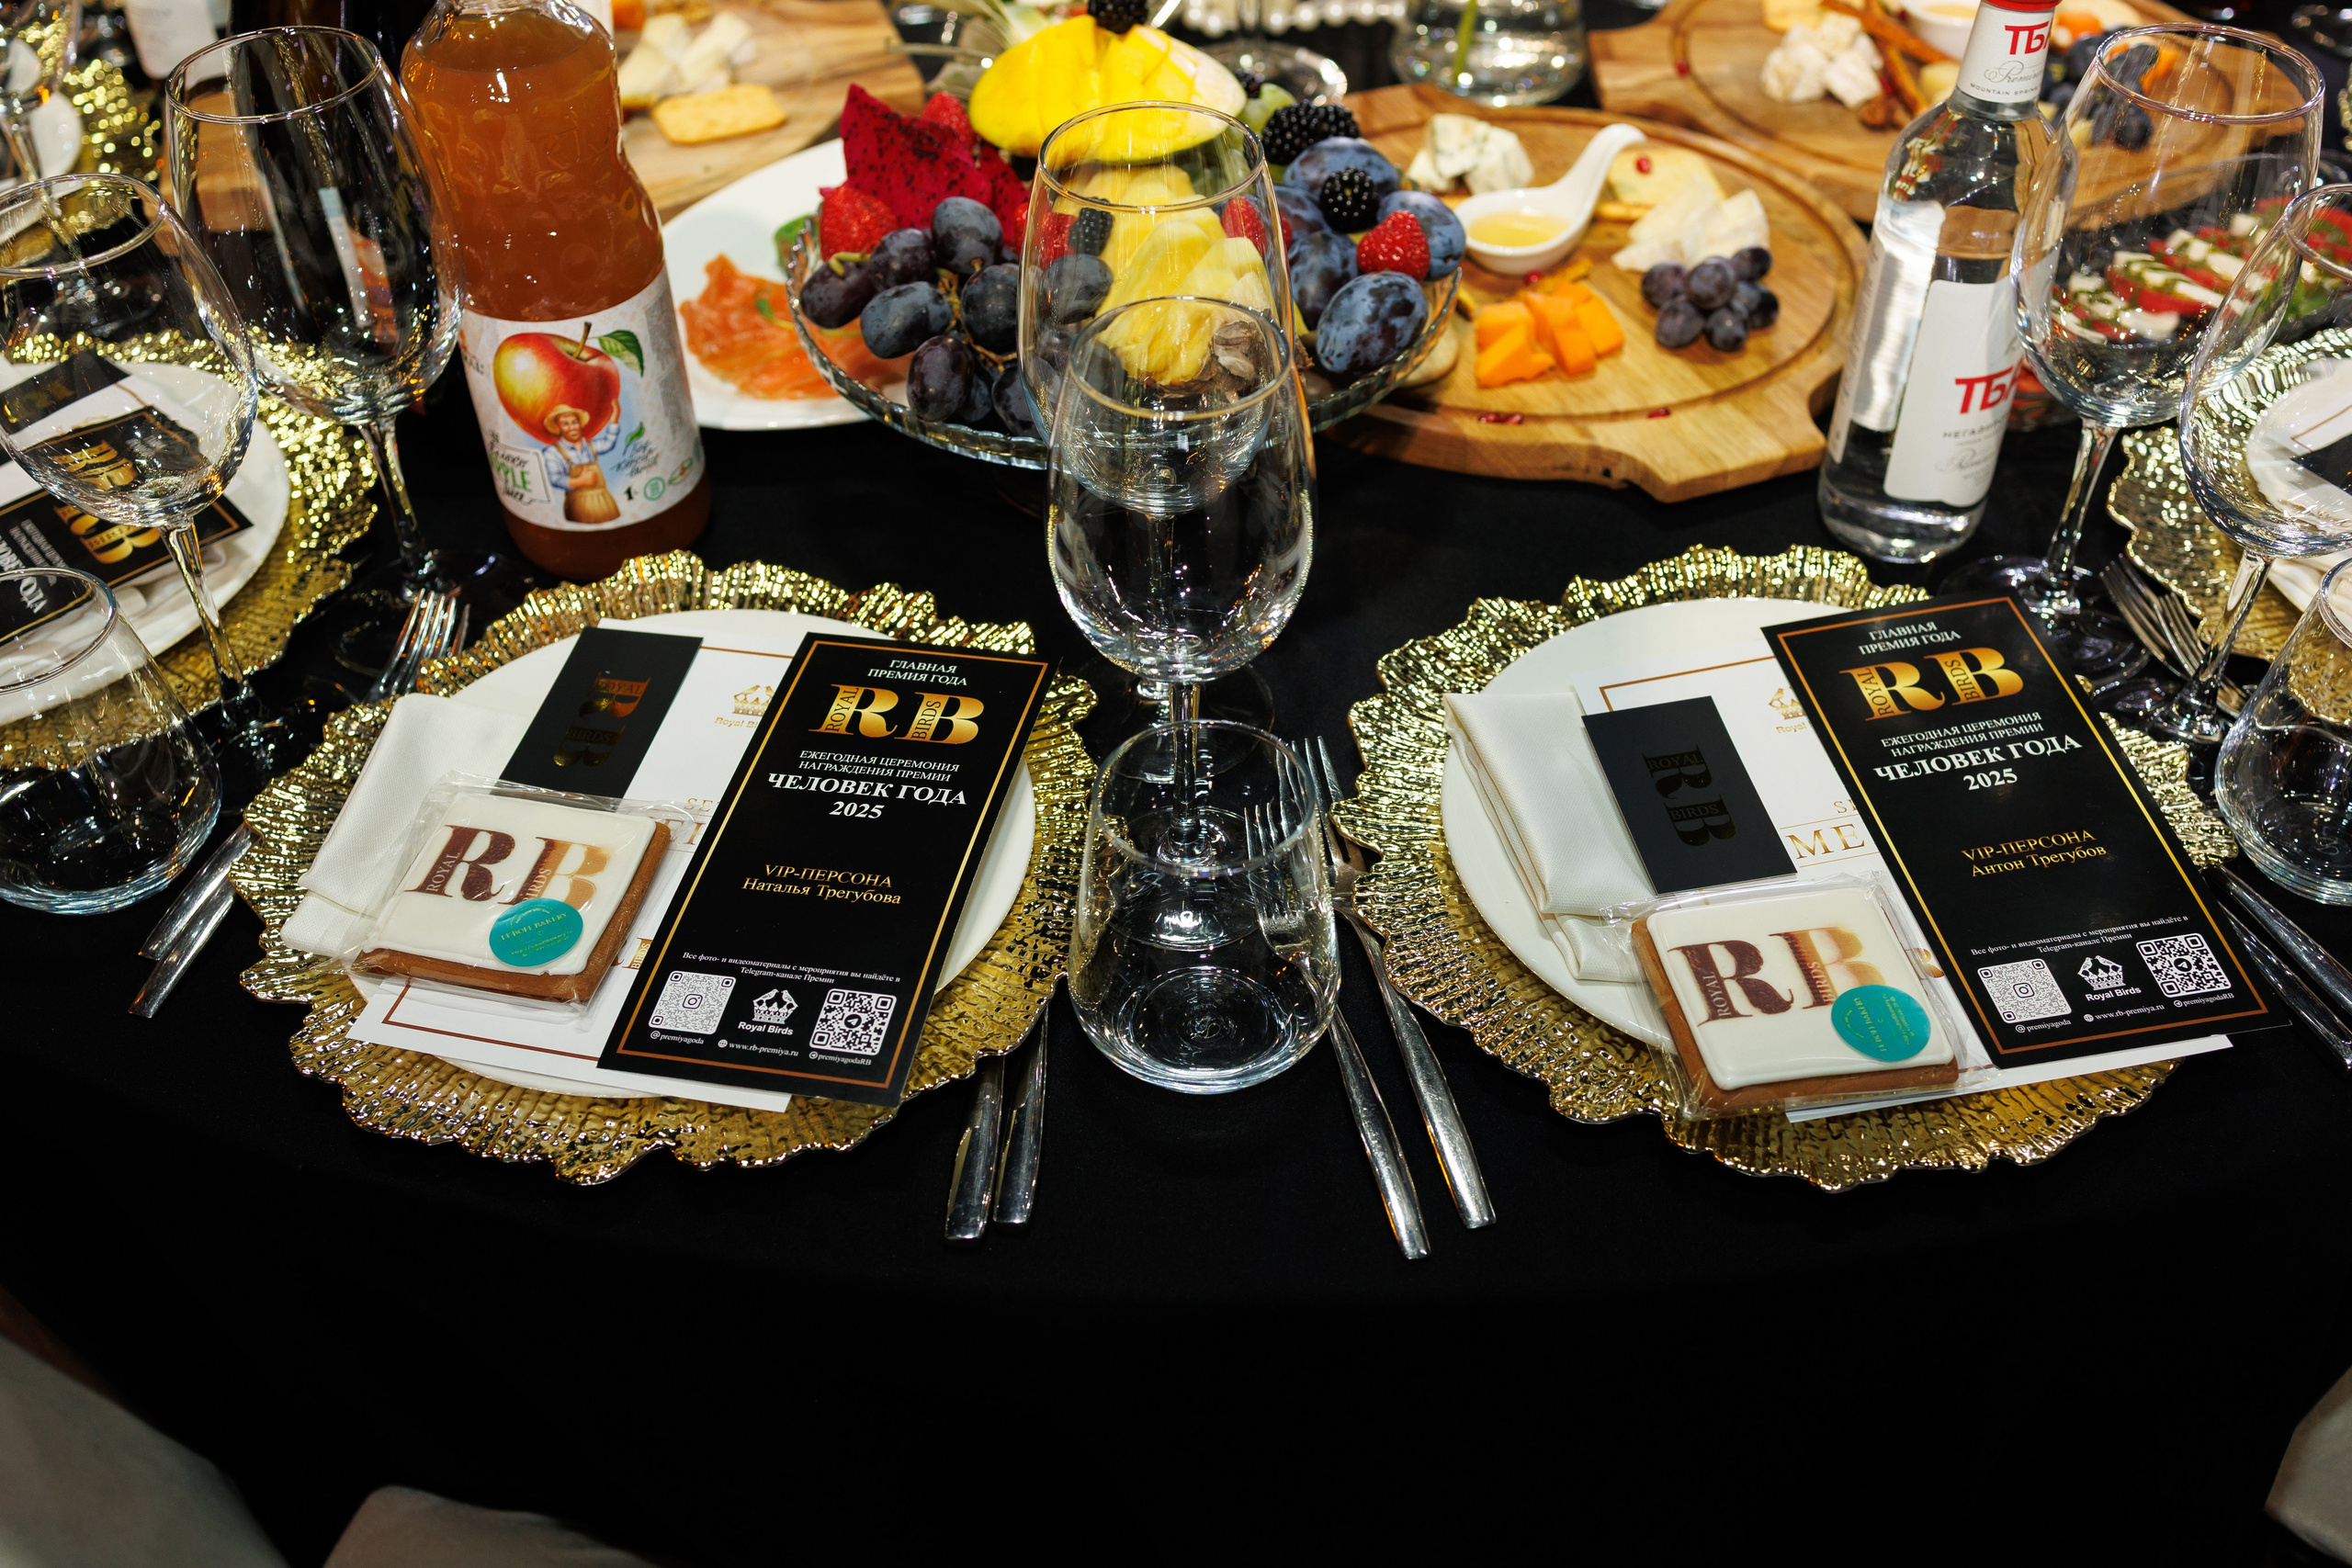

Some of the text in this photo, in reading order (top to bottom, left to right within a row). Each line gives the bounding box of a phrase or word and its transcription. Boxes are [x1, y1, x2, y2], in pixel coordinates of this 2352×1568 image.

[1970, 83, 2010, 96] MOUNTAIN
[19, 576, 48, 614] ОДА
[1858, 630, 1962, 656] ПРЕМИЯ ГОДА
[1869, 621, 1939, 641] ГЛАВНАЯ
[867, 669, 967, 686] ПРЕМИЯ ГОДА
[889, 660, 957, 673] ГЛАВНАЯ
[1857, 667, 1894, 716] ROYAL
[1944, 660, 1981, 702] BIRDS
[825, 687, 860, 732] ROYAL
[911, 700, 942, 739] BIRDS
[715, 716, 744, 728] Royal
[1776, 722, 1807, 733] Royal
[1881, 712, 2042, 748] ЕЖЕГОДНАЯ ЦЕРЕМОНИЯ
[1890, 722, 2044, 758] НАГРАЖДЕНИЯ ПРЕМИИ
[799, 750, 960, 773] ЕЖЕГОДНАЯ ЦЕРЕМОНИЯ
[1648, 753, 1704, 771] ROYAL
[1873, 735, 2083, 781] ЧЕЛОВЕК ГОДА
[798, 761, 952, 782] НАГРАЖДЕНИЯ ПРЕМИИ
[1962, 768, 2018, 791] 2025
[768, 773, 967, 806] ЧЕЛОВЕК ГОДА
[829, 801, 885, 819] 2025
[1668, 804, 1719, 820] BIRDS
[1961, 829, 2097, 861] VIP-ПЕРСОНА
[426, 852, 461, 893] ROYAL
[1972, 846, 2107, 876] Антон Трегубов
[764, 863, 892, 888] VIP-ПЕРСОНА
[741, 877, 901, 904] Наталья Трегубова
[1971, 947, 1986, 956] Все
[1987, 944, 2010, 954] фото-
[2018, 931, 2082, 948] видеоматериалы
[2088, 921, 2139, 937] мероприятия
[2152, 916, 2181, 926] найдёте
[2036, 933, 2132, 953] Telegram-канале Премии
[631, 943, 650, 968] BIRDS
[682, 952, 697, 960] Все
[698, 953, 720, 964] фото-
[728, 957, 791, 971] видеоматериалы
[798, 965, 849, 978] мероприятия
[863, 973, 895, 982] найдёте
[741, 966, 835, 984] Telegram-канале Премии
[1807, 961, 1836, 1004] BIRDS
[1702, 971, 1731, 1017] ROYAL
[2085, 986, 2142, 1002] Royal Birds
[2183, 992, 2234, 1008] premiyagodaRB
[2095, 1003, 2165, 1021] www.rb-premiya.ru
[739, 1021, 794, 1036] Royal Birds
[729, 1042, 799, 1058] www.rb-premiya.ru
[818, 1055, 872, 1066] premiyagodaRB
